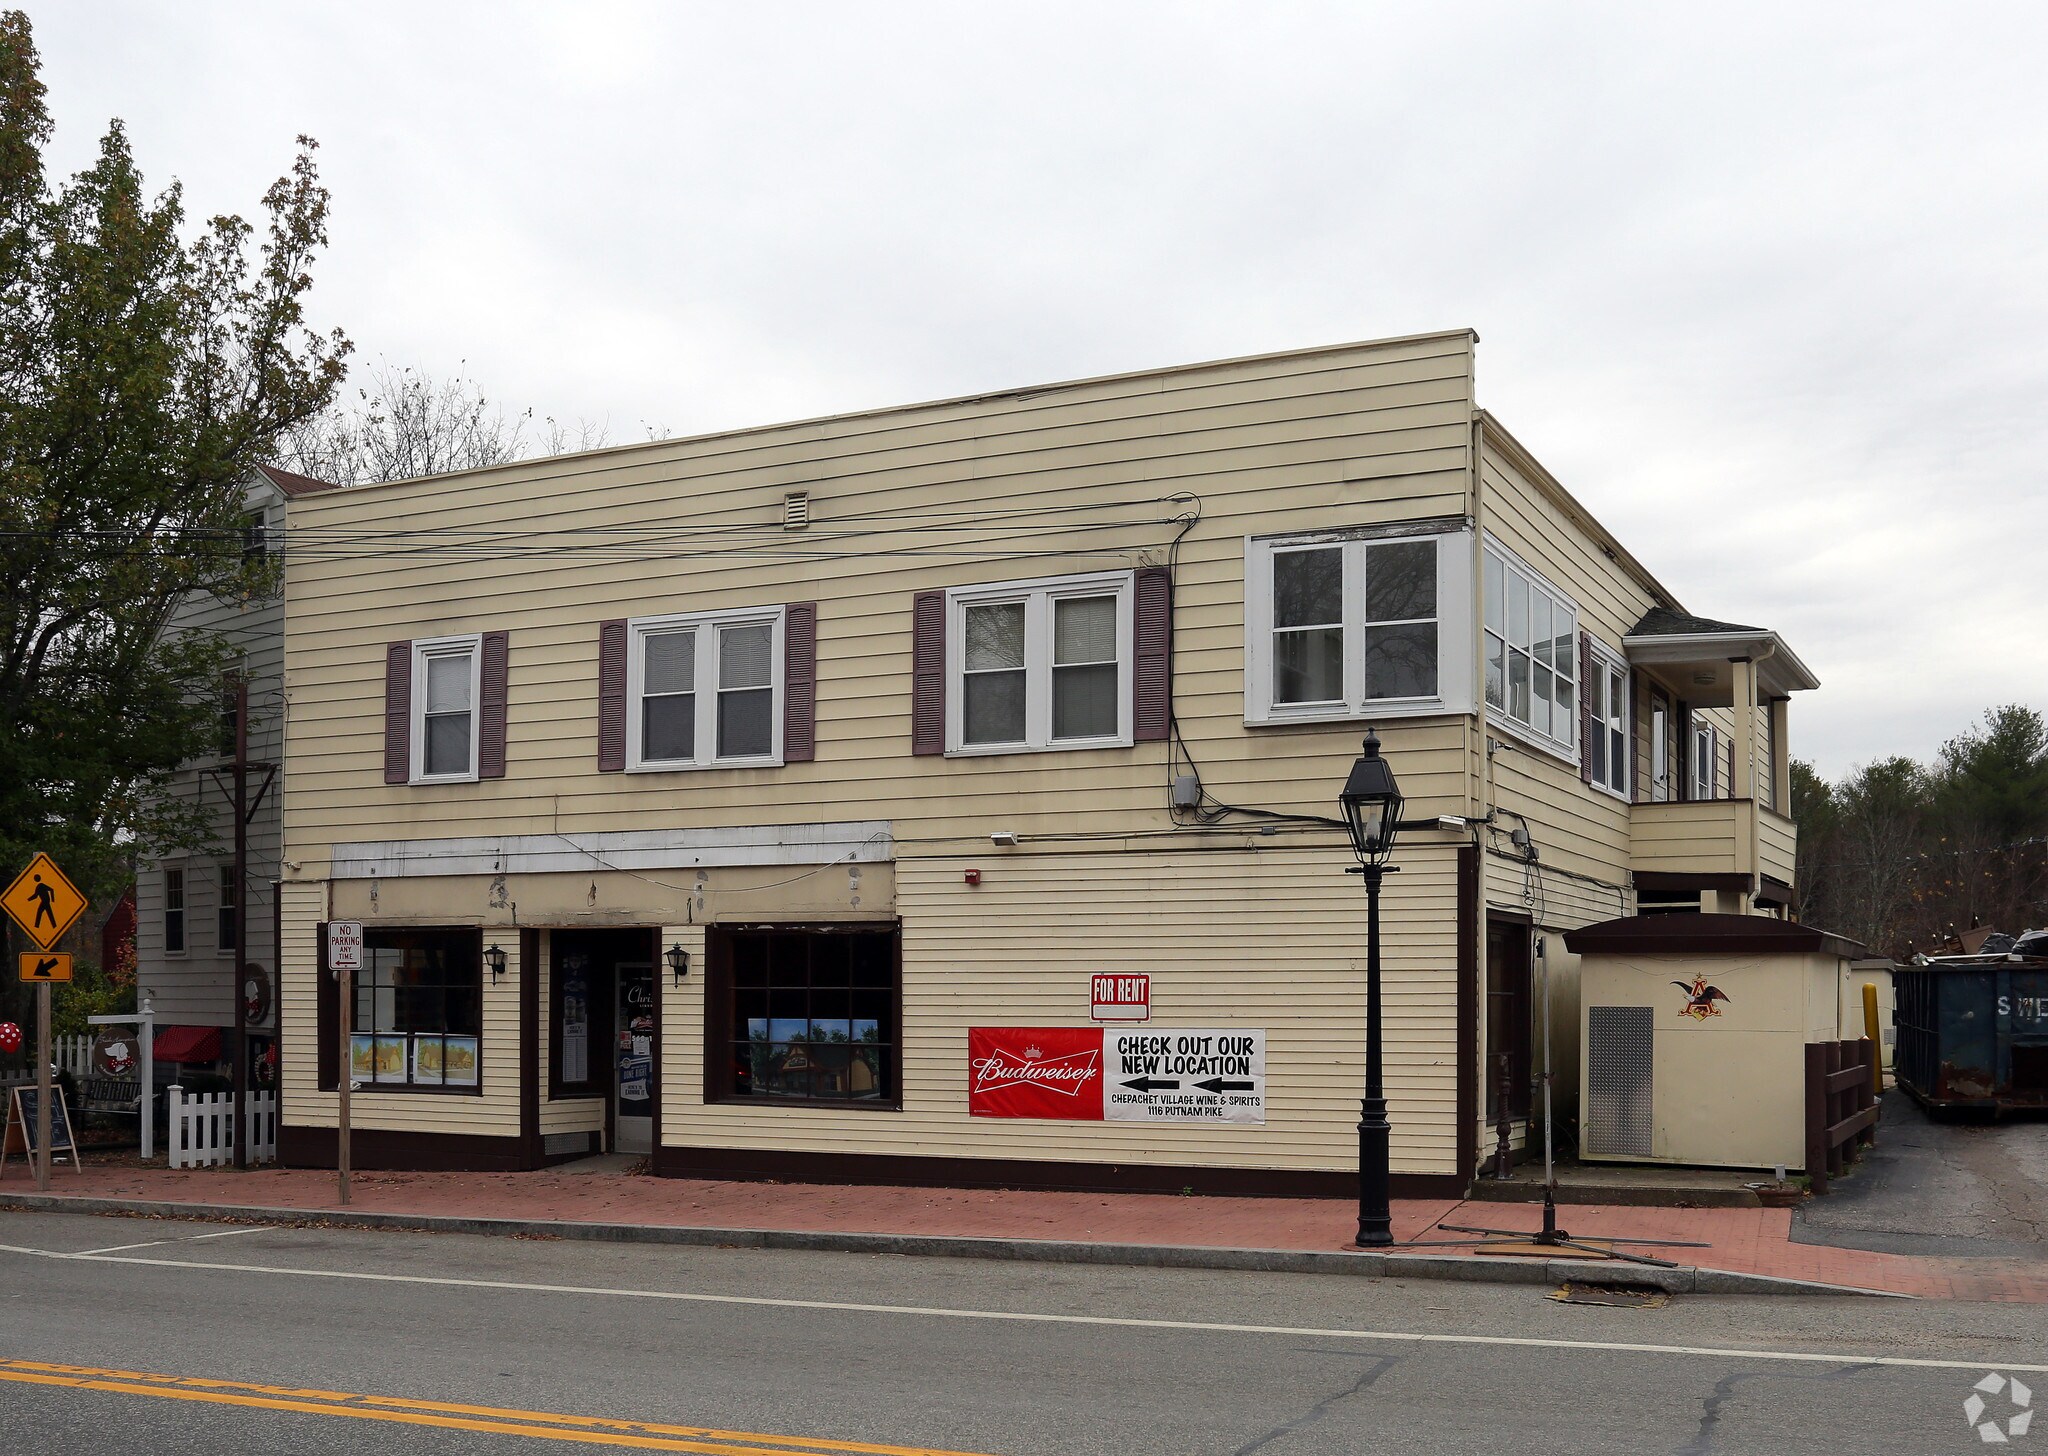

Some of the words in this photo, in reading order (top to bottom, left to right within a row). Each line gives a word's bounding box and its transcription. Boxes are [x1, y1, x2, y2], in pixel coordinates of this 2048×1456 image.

[340, 926, 352, 935] NO
[332, 936, 360, 946] PARKING
[1094, 978, 1114, 1002] FOR
[1117, 978, 1147, 1002] RENT
[1117, 1036, 1172, 1055] CHECK
[1177, 1036, 1213, 1056] OUT
[1217, 1036, 1255, 1056] OUR
[972, 1058, 1098, 1081] Budweiser
[1121, 1056, 1160, 1075] NEW
[1164, 1056, 1250, 1075] LOCATION
[1111, 1093, 1159, 1105] CHEPACHET
[1160, 1095, 1194, 1105] VILLAGE
[1195, 1095, 1218, 1105] WINE
[1219, 1096, 1227, 1106] &
[1228, 1096, 1261, 1106] SPIRITS
[1147, 1106, 1163, 1116] 1116
[1165, 1106, 1203, 1116] PUTNAM
[1204, 1107, 1223, 1117] PIKE
